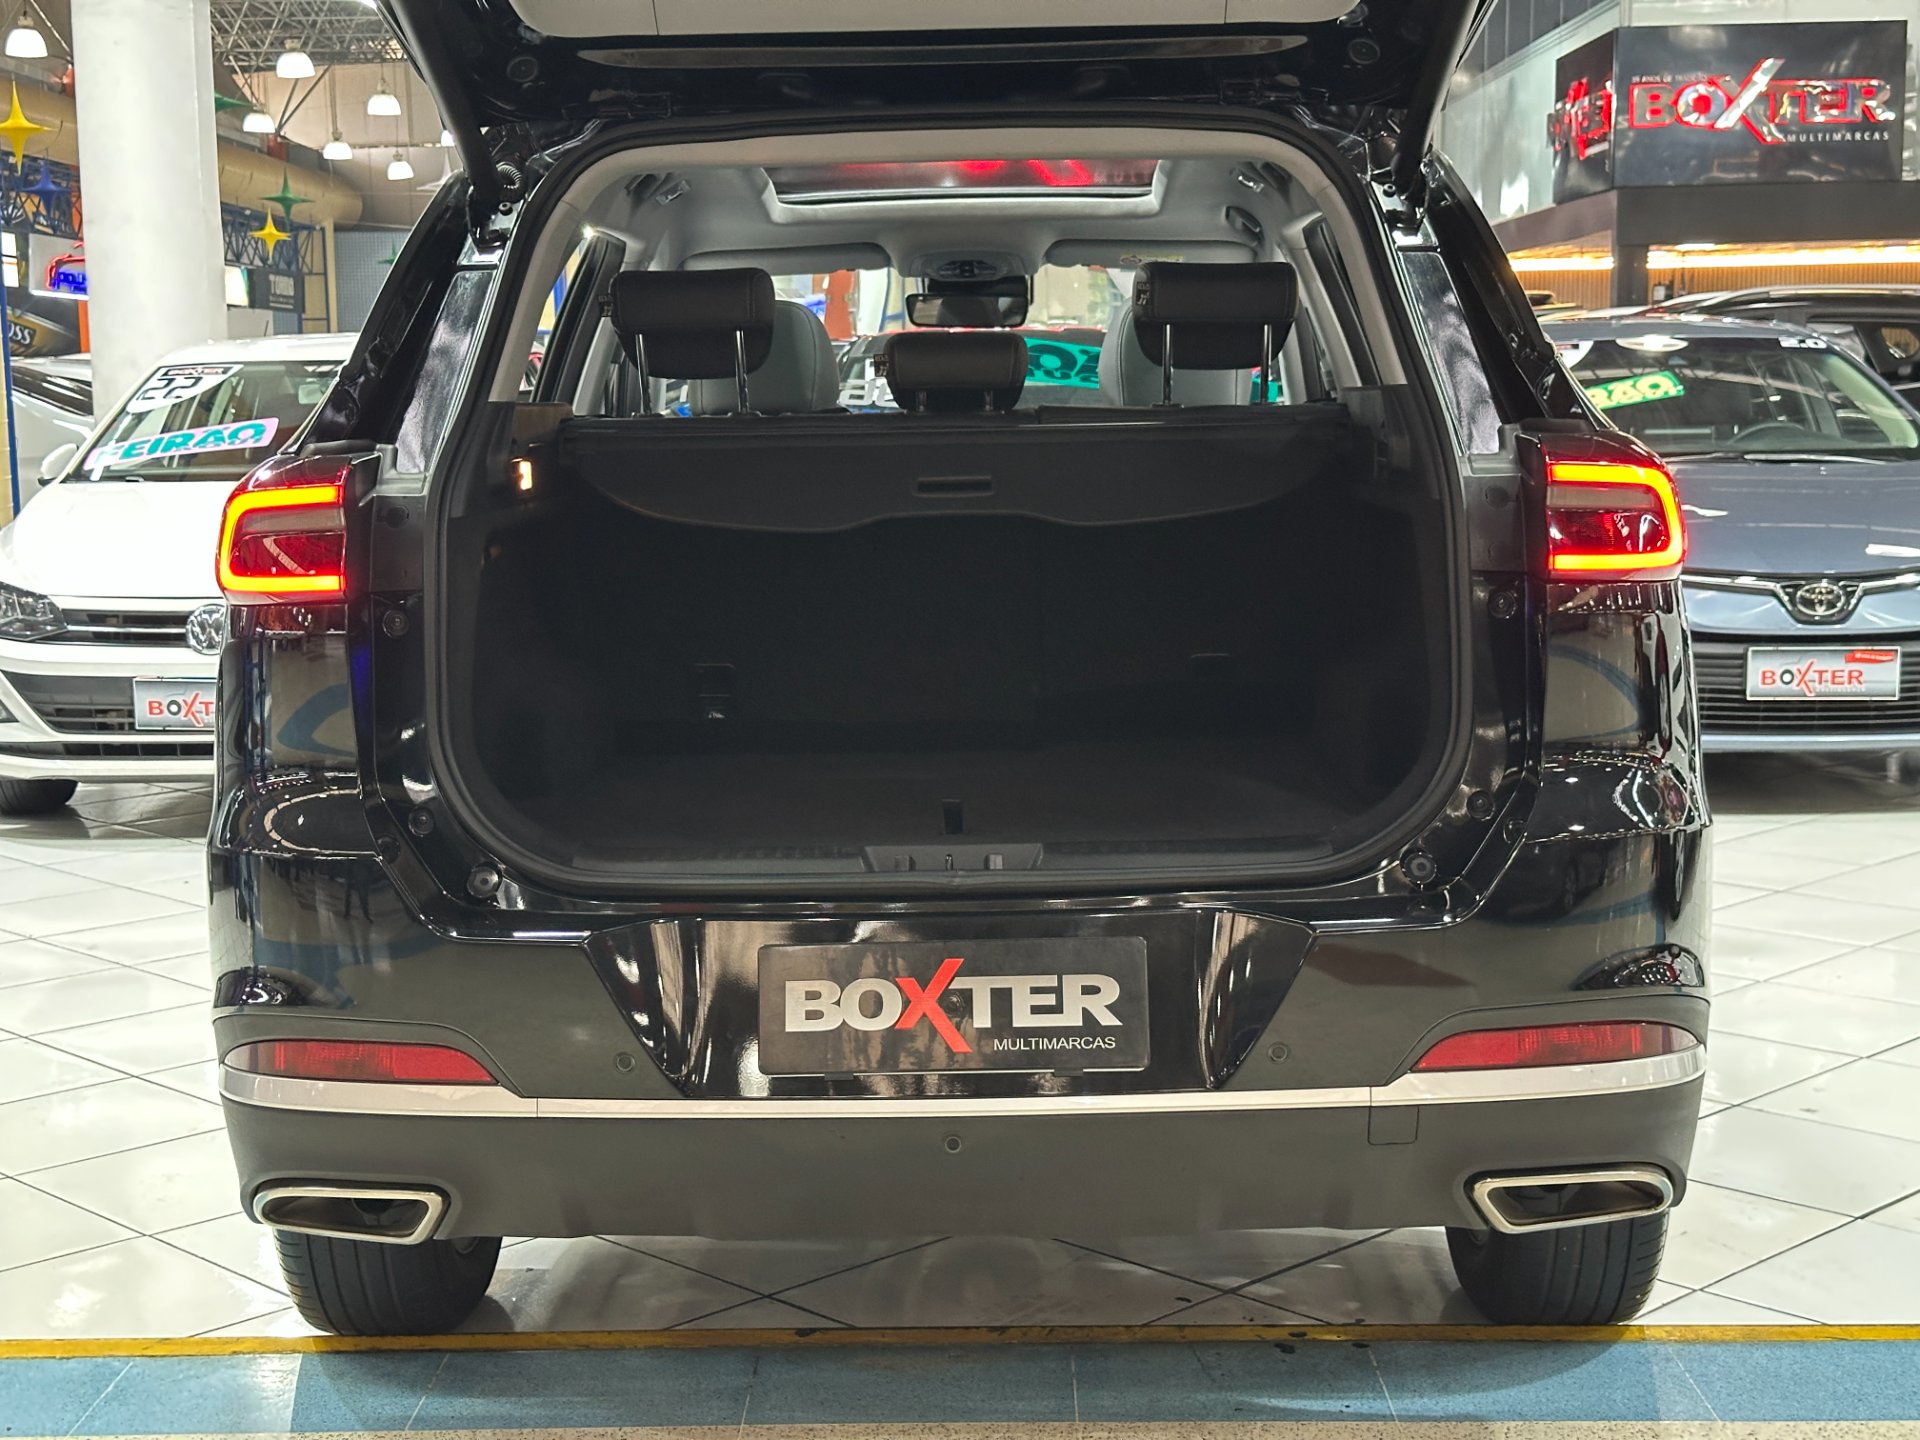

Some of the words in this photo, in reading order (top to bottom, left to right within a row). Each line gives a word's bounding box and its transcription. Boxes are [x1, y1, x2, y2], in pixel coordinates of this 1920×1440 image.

[1629, 57, 1897, 144] BOXTER
[1786, 130, 1889, 143] MULTIMARCAS
[1585, 374, 1676, 406] RÃO
[1760, 660, 1864, 695] BOXTER
[148, 692, 215, 725] BOXT
[785, 958, 1123, 1054] BOXTER
[994, 1036, 1116, 1051] MULTIMARCAS
